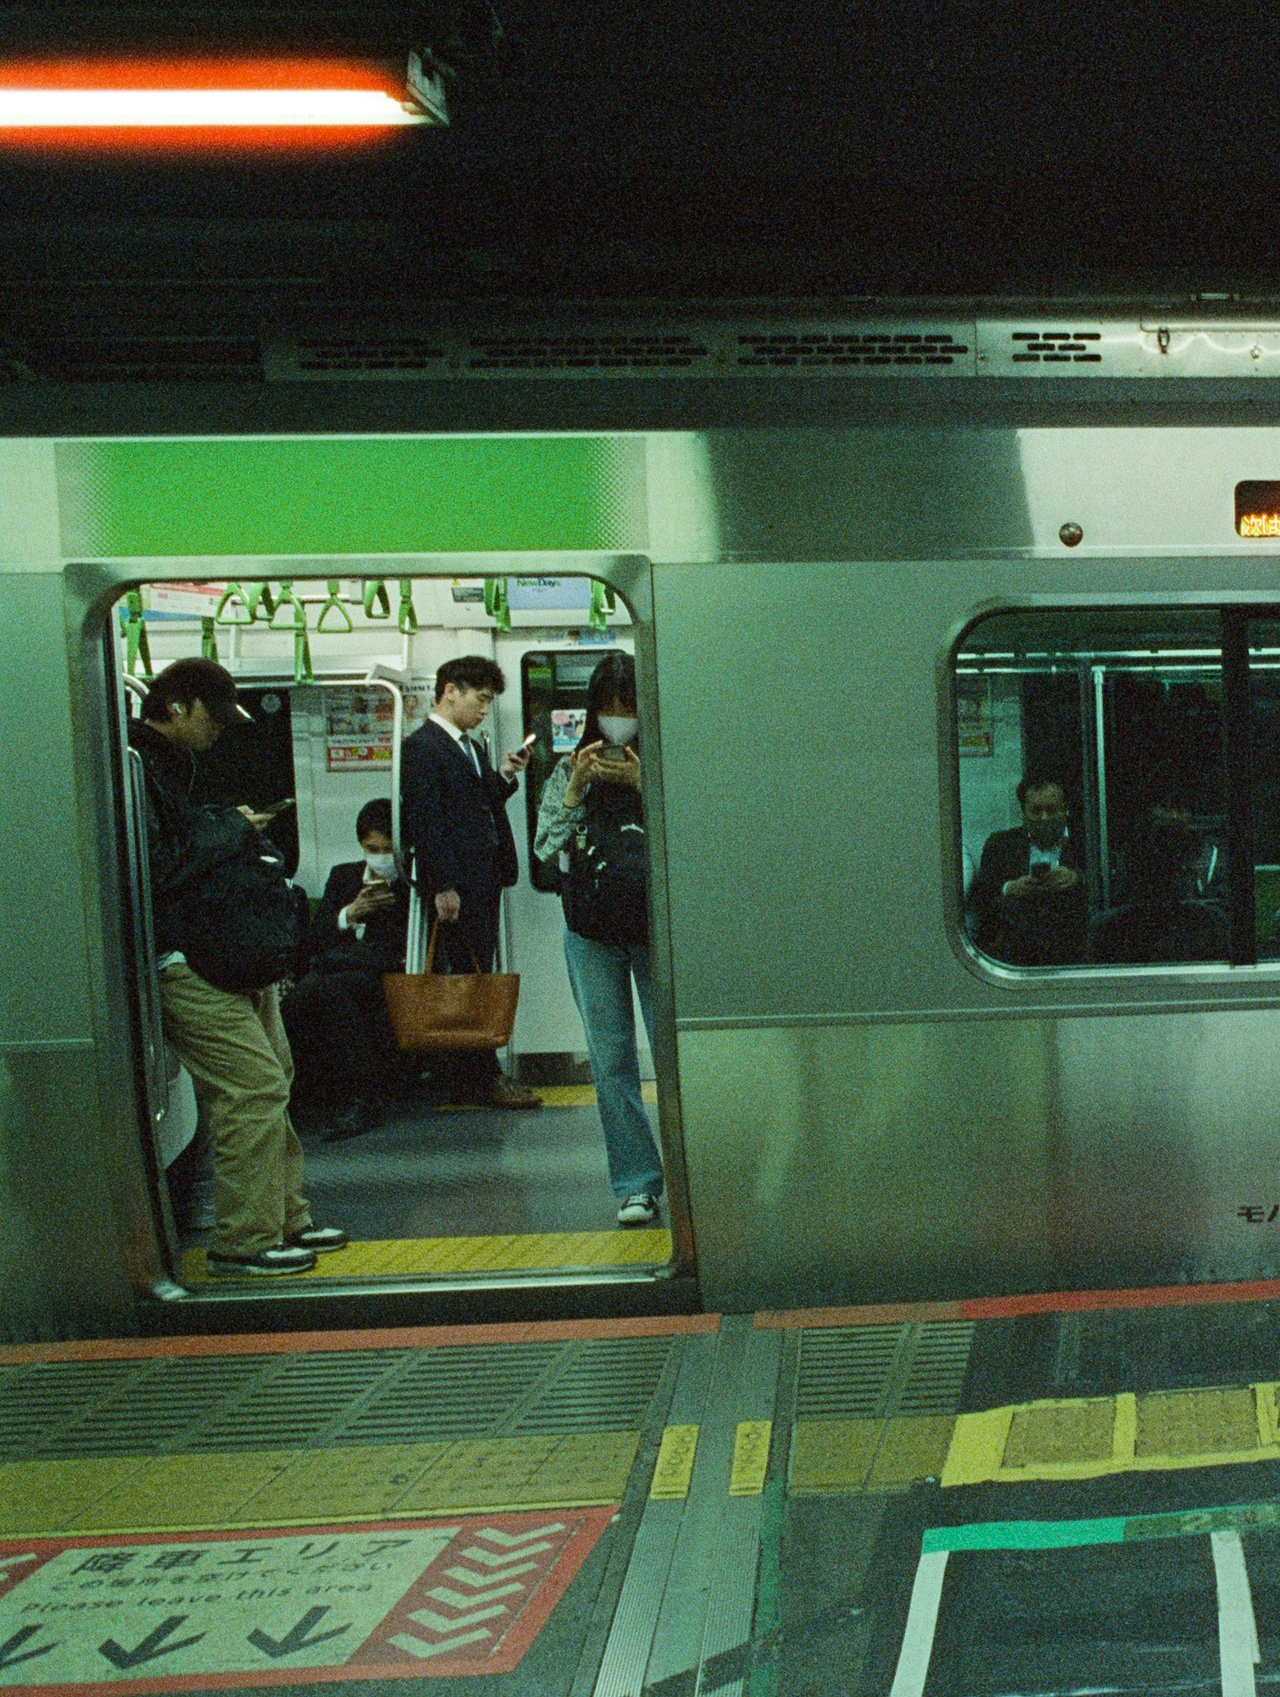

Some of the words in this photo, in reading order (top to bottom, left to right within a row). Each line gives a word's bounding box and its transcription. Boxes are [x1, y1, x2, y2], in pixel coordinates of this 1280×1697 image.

[71, 1539, 413, 1575] 降車エリア
[20, 1599, 124, 1613] Please
[137, 1594, 222, 1607] leave
[236, 1587, 292, 1601] this
[304, 1583, 373, 1595] area
